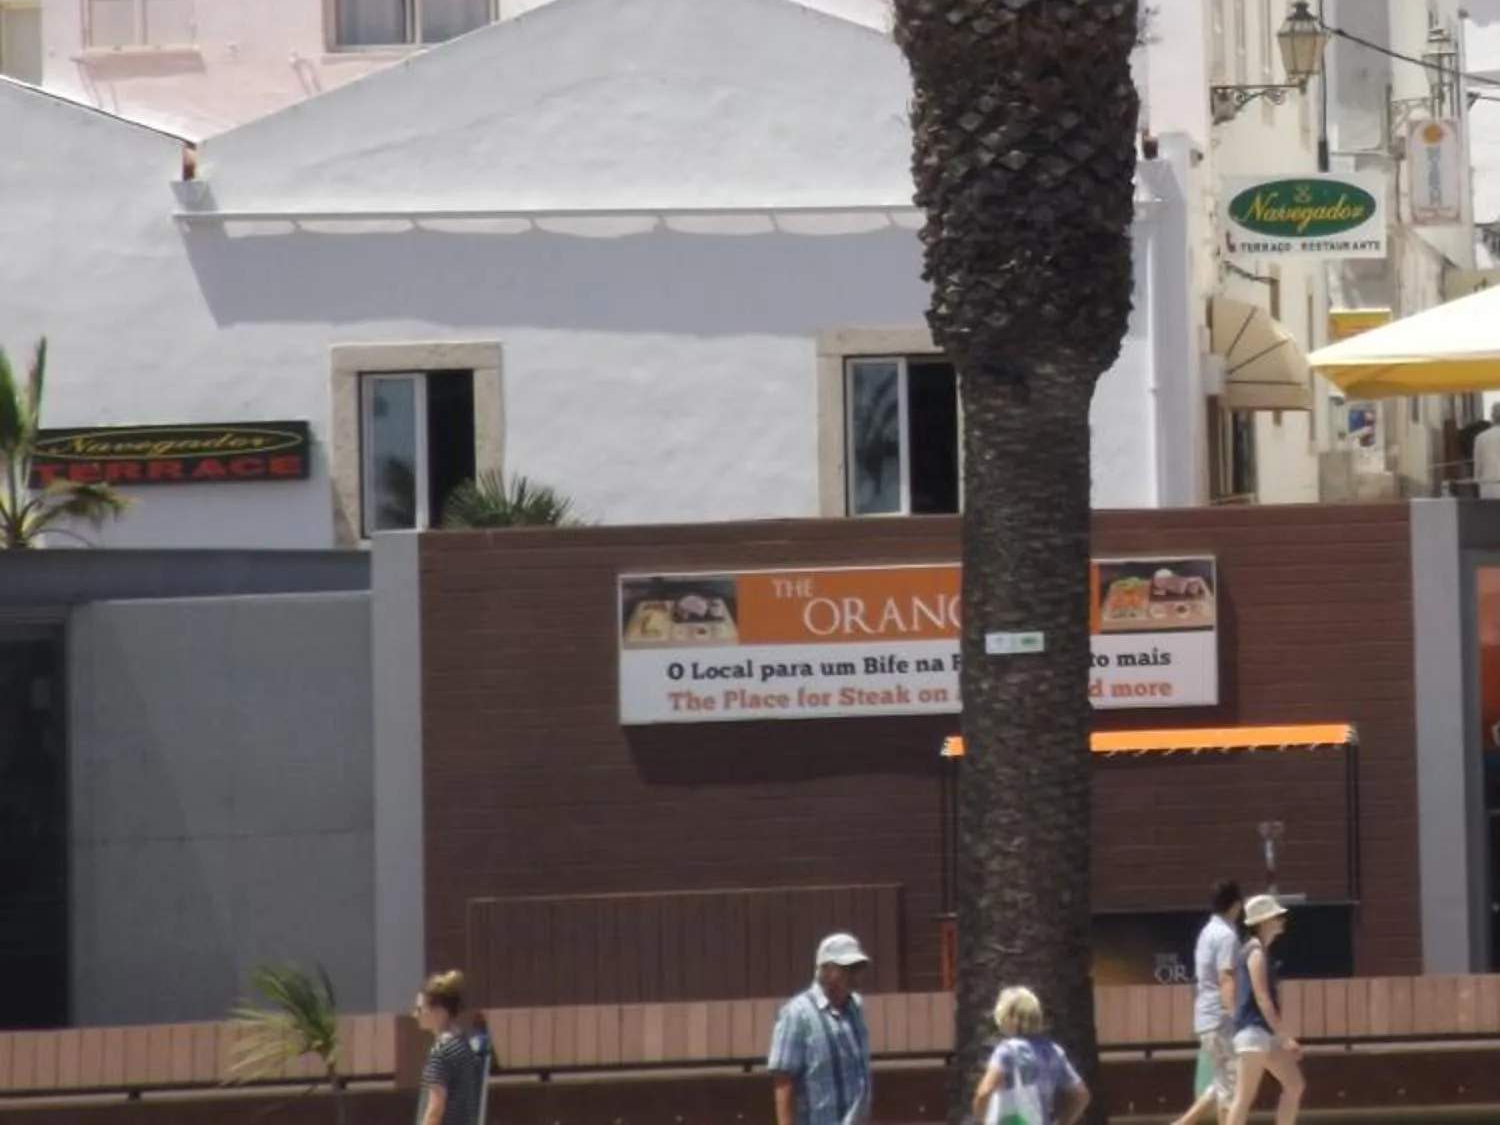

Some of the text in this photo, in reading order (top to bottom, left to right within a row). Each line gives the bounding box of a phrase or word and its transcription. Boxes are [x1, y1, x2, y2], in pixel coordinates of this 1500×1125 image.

[1237, 191, 1364, 232] Navegador
[1301, 241, 1381, 252] RESTAURANTE
[33, 455, 301, 482] TERRACE
[772, 578, 814, 599] THE
[667, 662, 685, 680] O
[691, 659, 754, 680] Local
[760, 660, 813, 682] para
[820, 659, 857, 676] um
[863, 654, 909, 675] Bife
[916, 654, 944, 673] na
[1116, 645, 1172, 667] mais
[668, 691, 716, 711] The
[722, 688, 790, 710] Place
[796, 687, 832, 708] for
[838, 684, 911, 706] Steak
[918, 686, 949, 703] on
[1111, 681, 1174, 698] more
